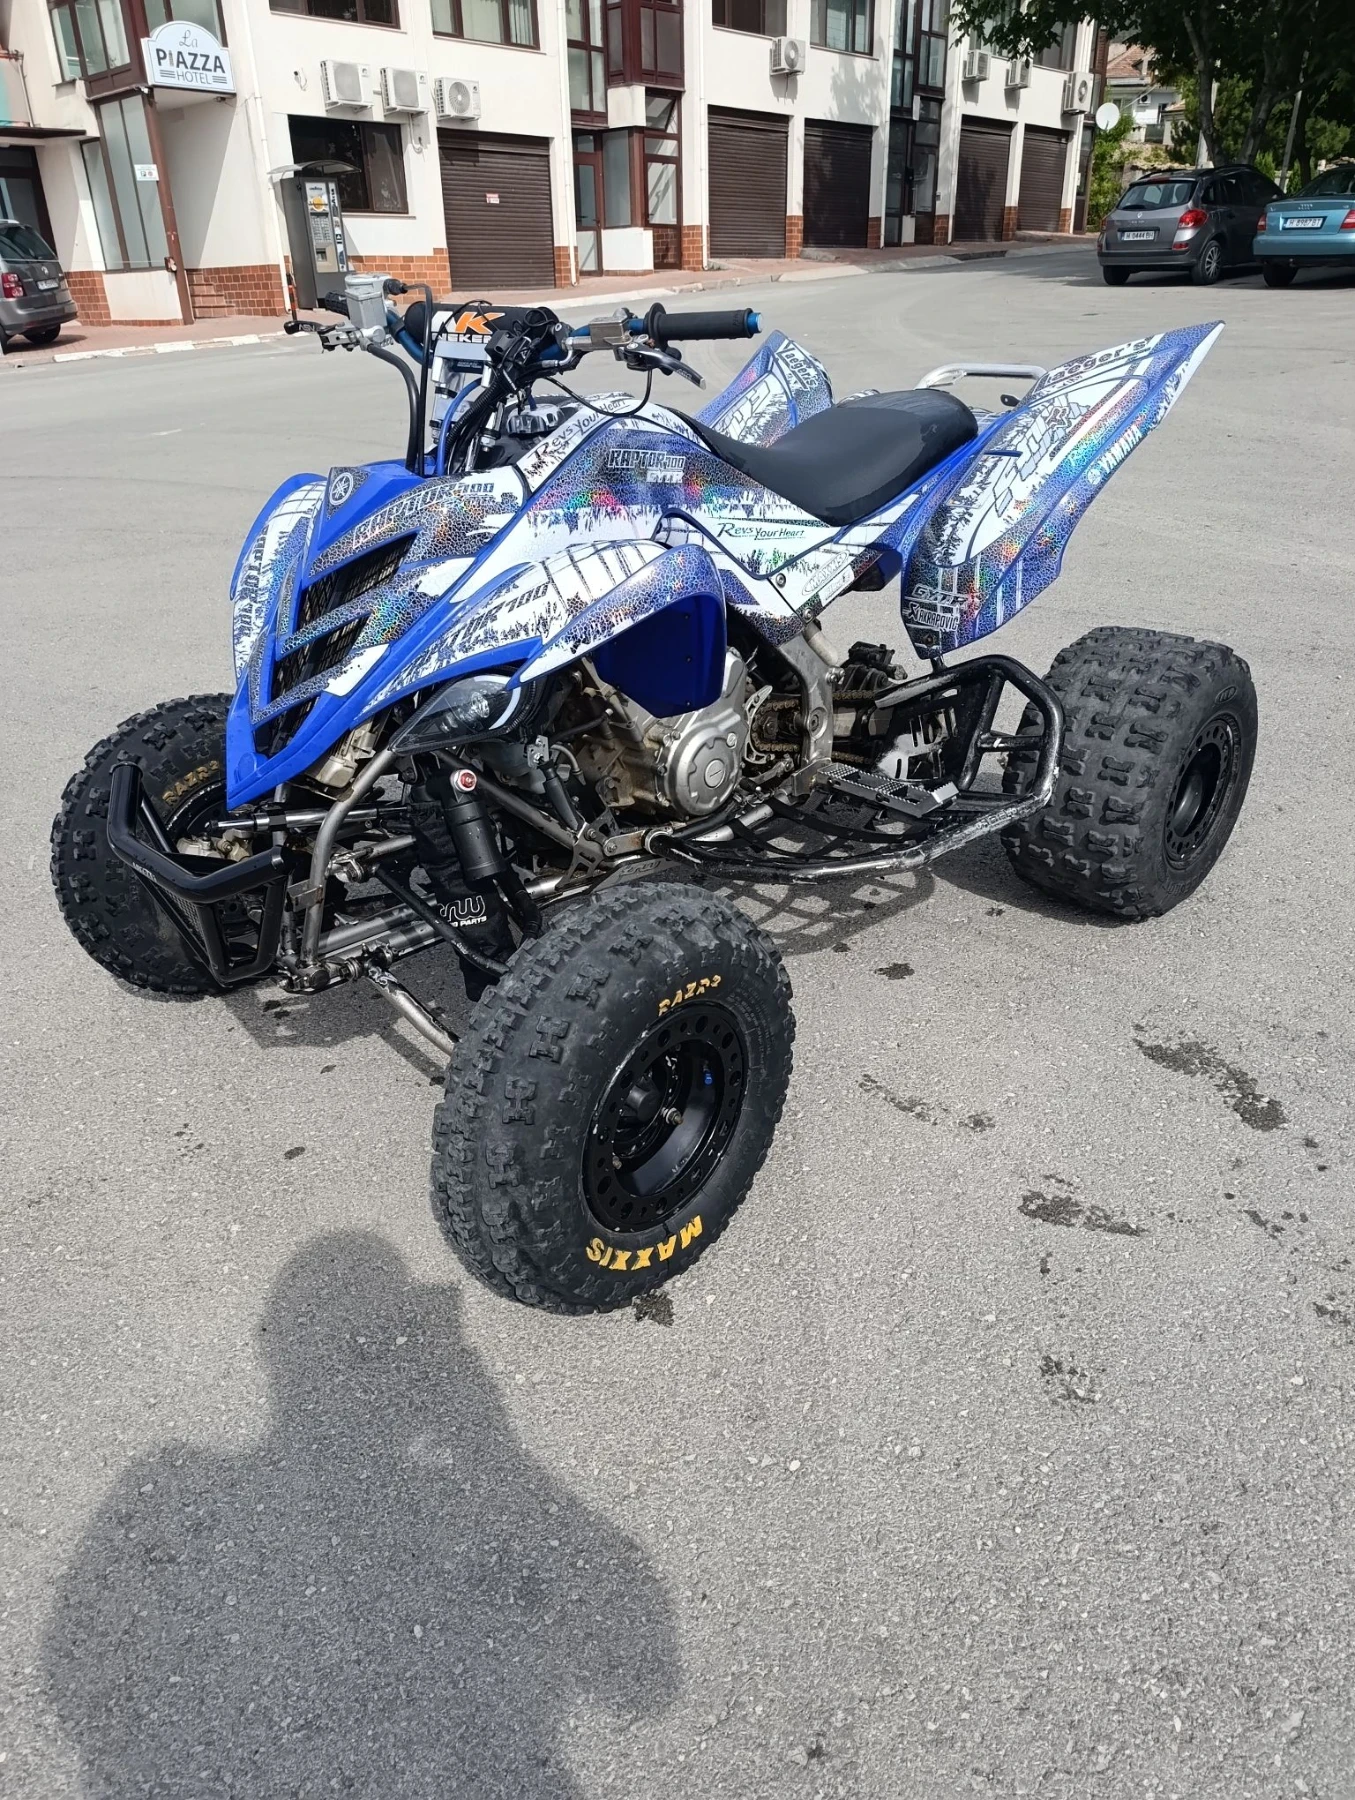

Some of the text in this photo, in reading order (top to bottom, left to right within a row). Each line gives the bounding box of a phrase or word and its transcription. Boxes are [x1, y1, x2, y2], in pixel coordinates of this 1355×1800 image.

[179, 30, 198, 48] La
[155, 48, 226, 74] PIAZZA
[176, 70, 212, 84] HOTEL
[527, 426, 574, 460] Revs
[573, 411, 600, 436] Your
[1097, 423, 1143, 475] YAMAHA
[716, 523, 805, 541] Revs Your Heart
[460, 916, 487, 927] PARTS
[586, 1215, 703, 1270] MAXXIS
